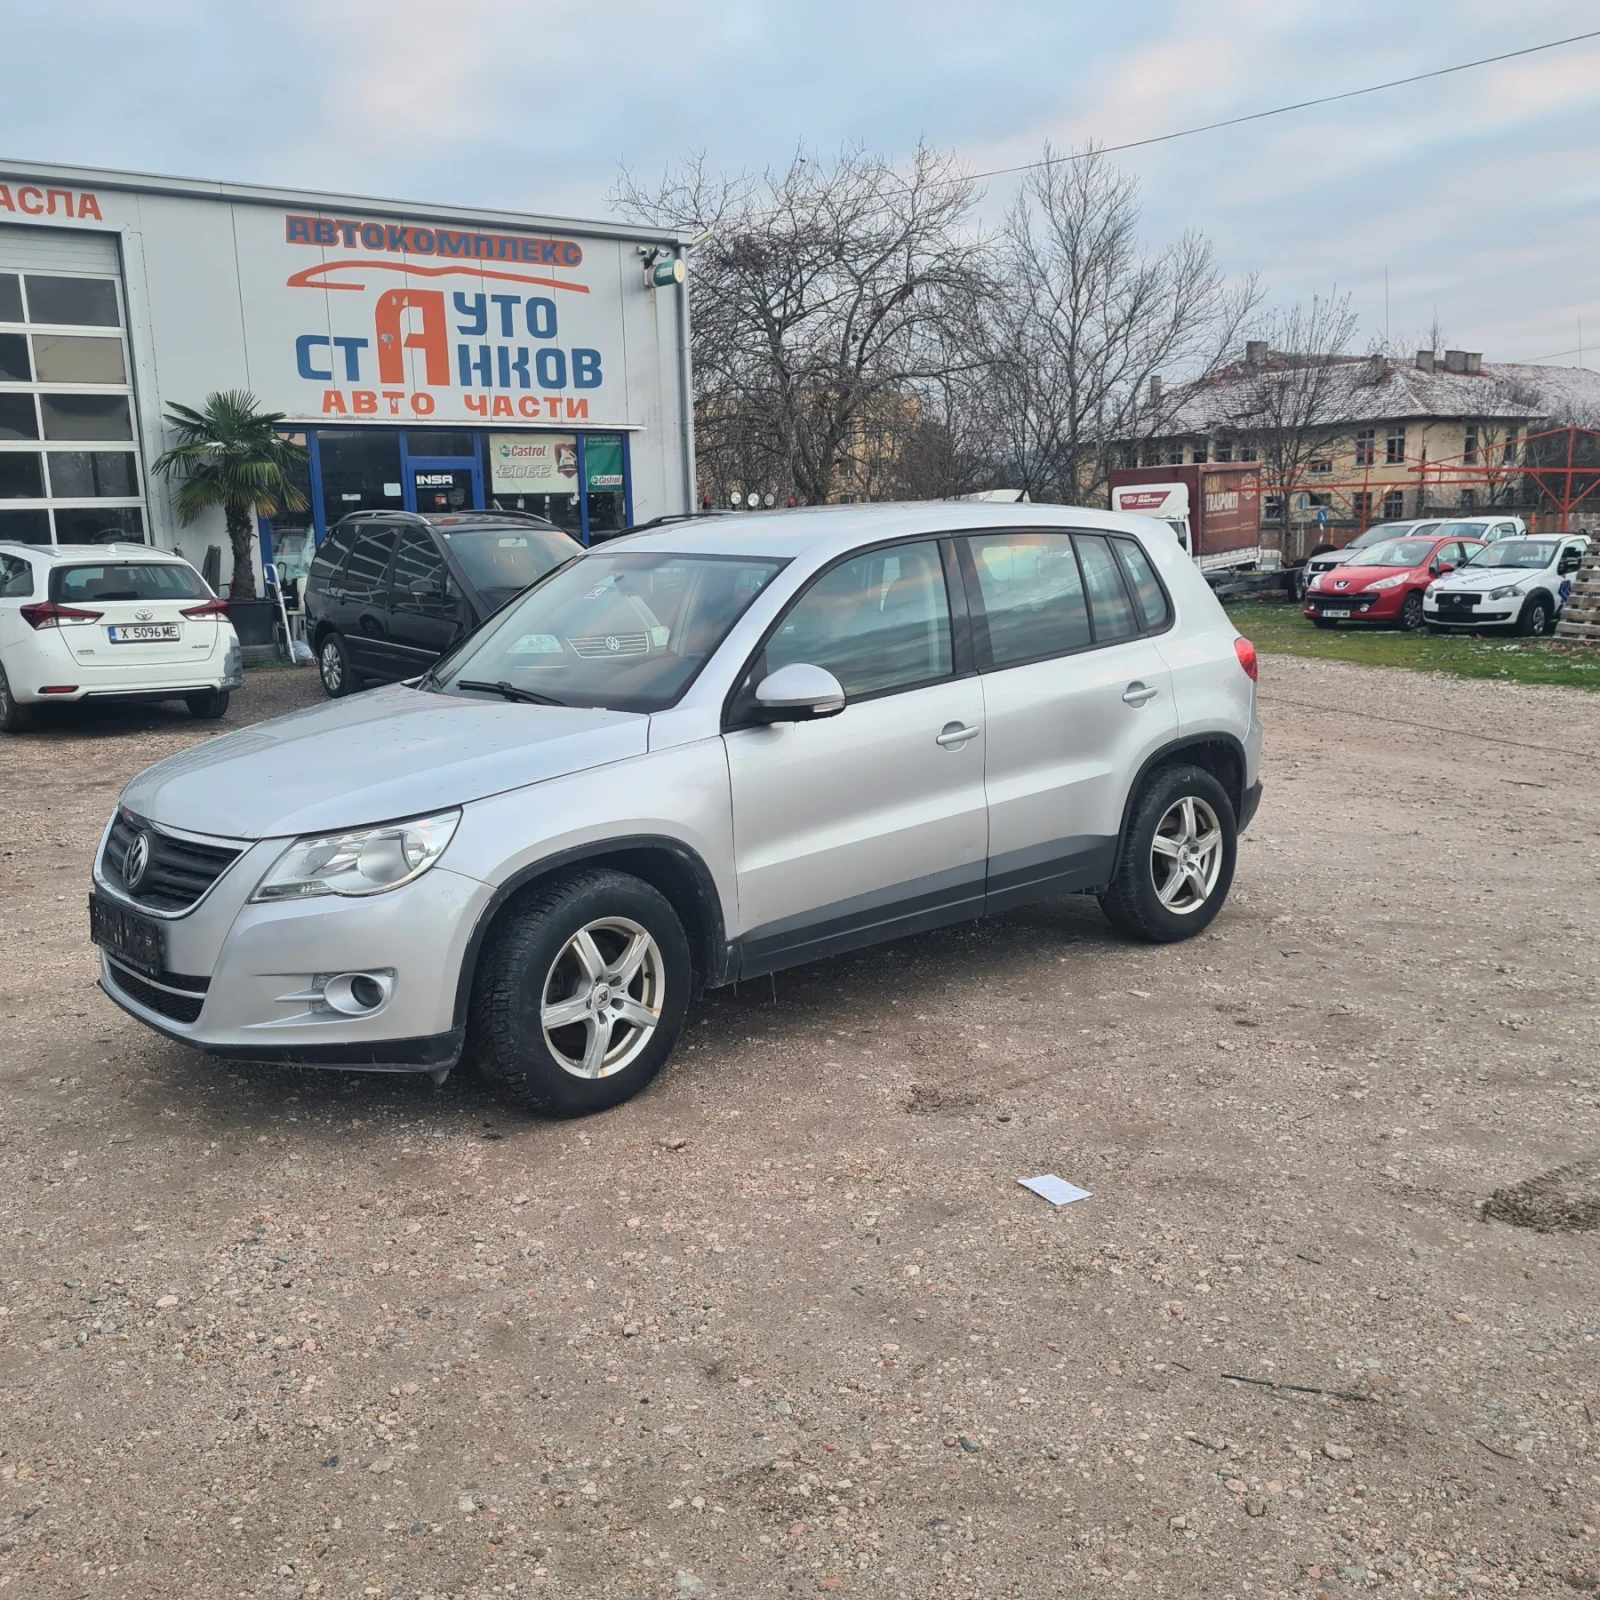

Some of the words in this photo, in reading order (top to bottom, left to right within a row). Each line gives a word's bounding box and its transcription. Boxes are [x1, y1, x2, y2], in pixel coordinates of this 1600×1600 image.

[286, 215, 582, 267] АВТОКОМПЛЕКС
[322, 390, 435, 415] АВТО
[463, 394, 589, 419] ЧАСТИ
[511, 445, 546, 457] Castrol
[496, 464, 552, 478] EDGE
[416, 474, 453, 485] INSA
[598, 475, 621, 484] Castrol
[1206, 491, 1239, 512] TRASPORTI
[121, 627, 129, 639] X
[133, 627, 161, 638] 5096
[162, 626, 178, 637] ME
